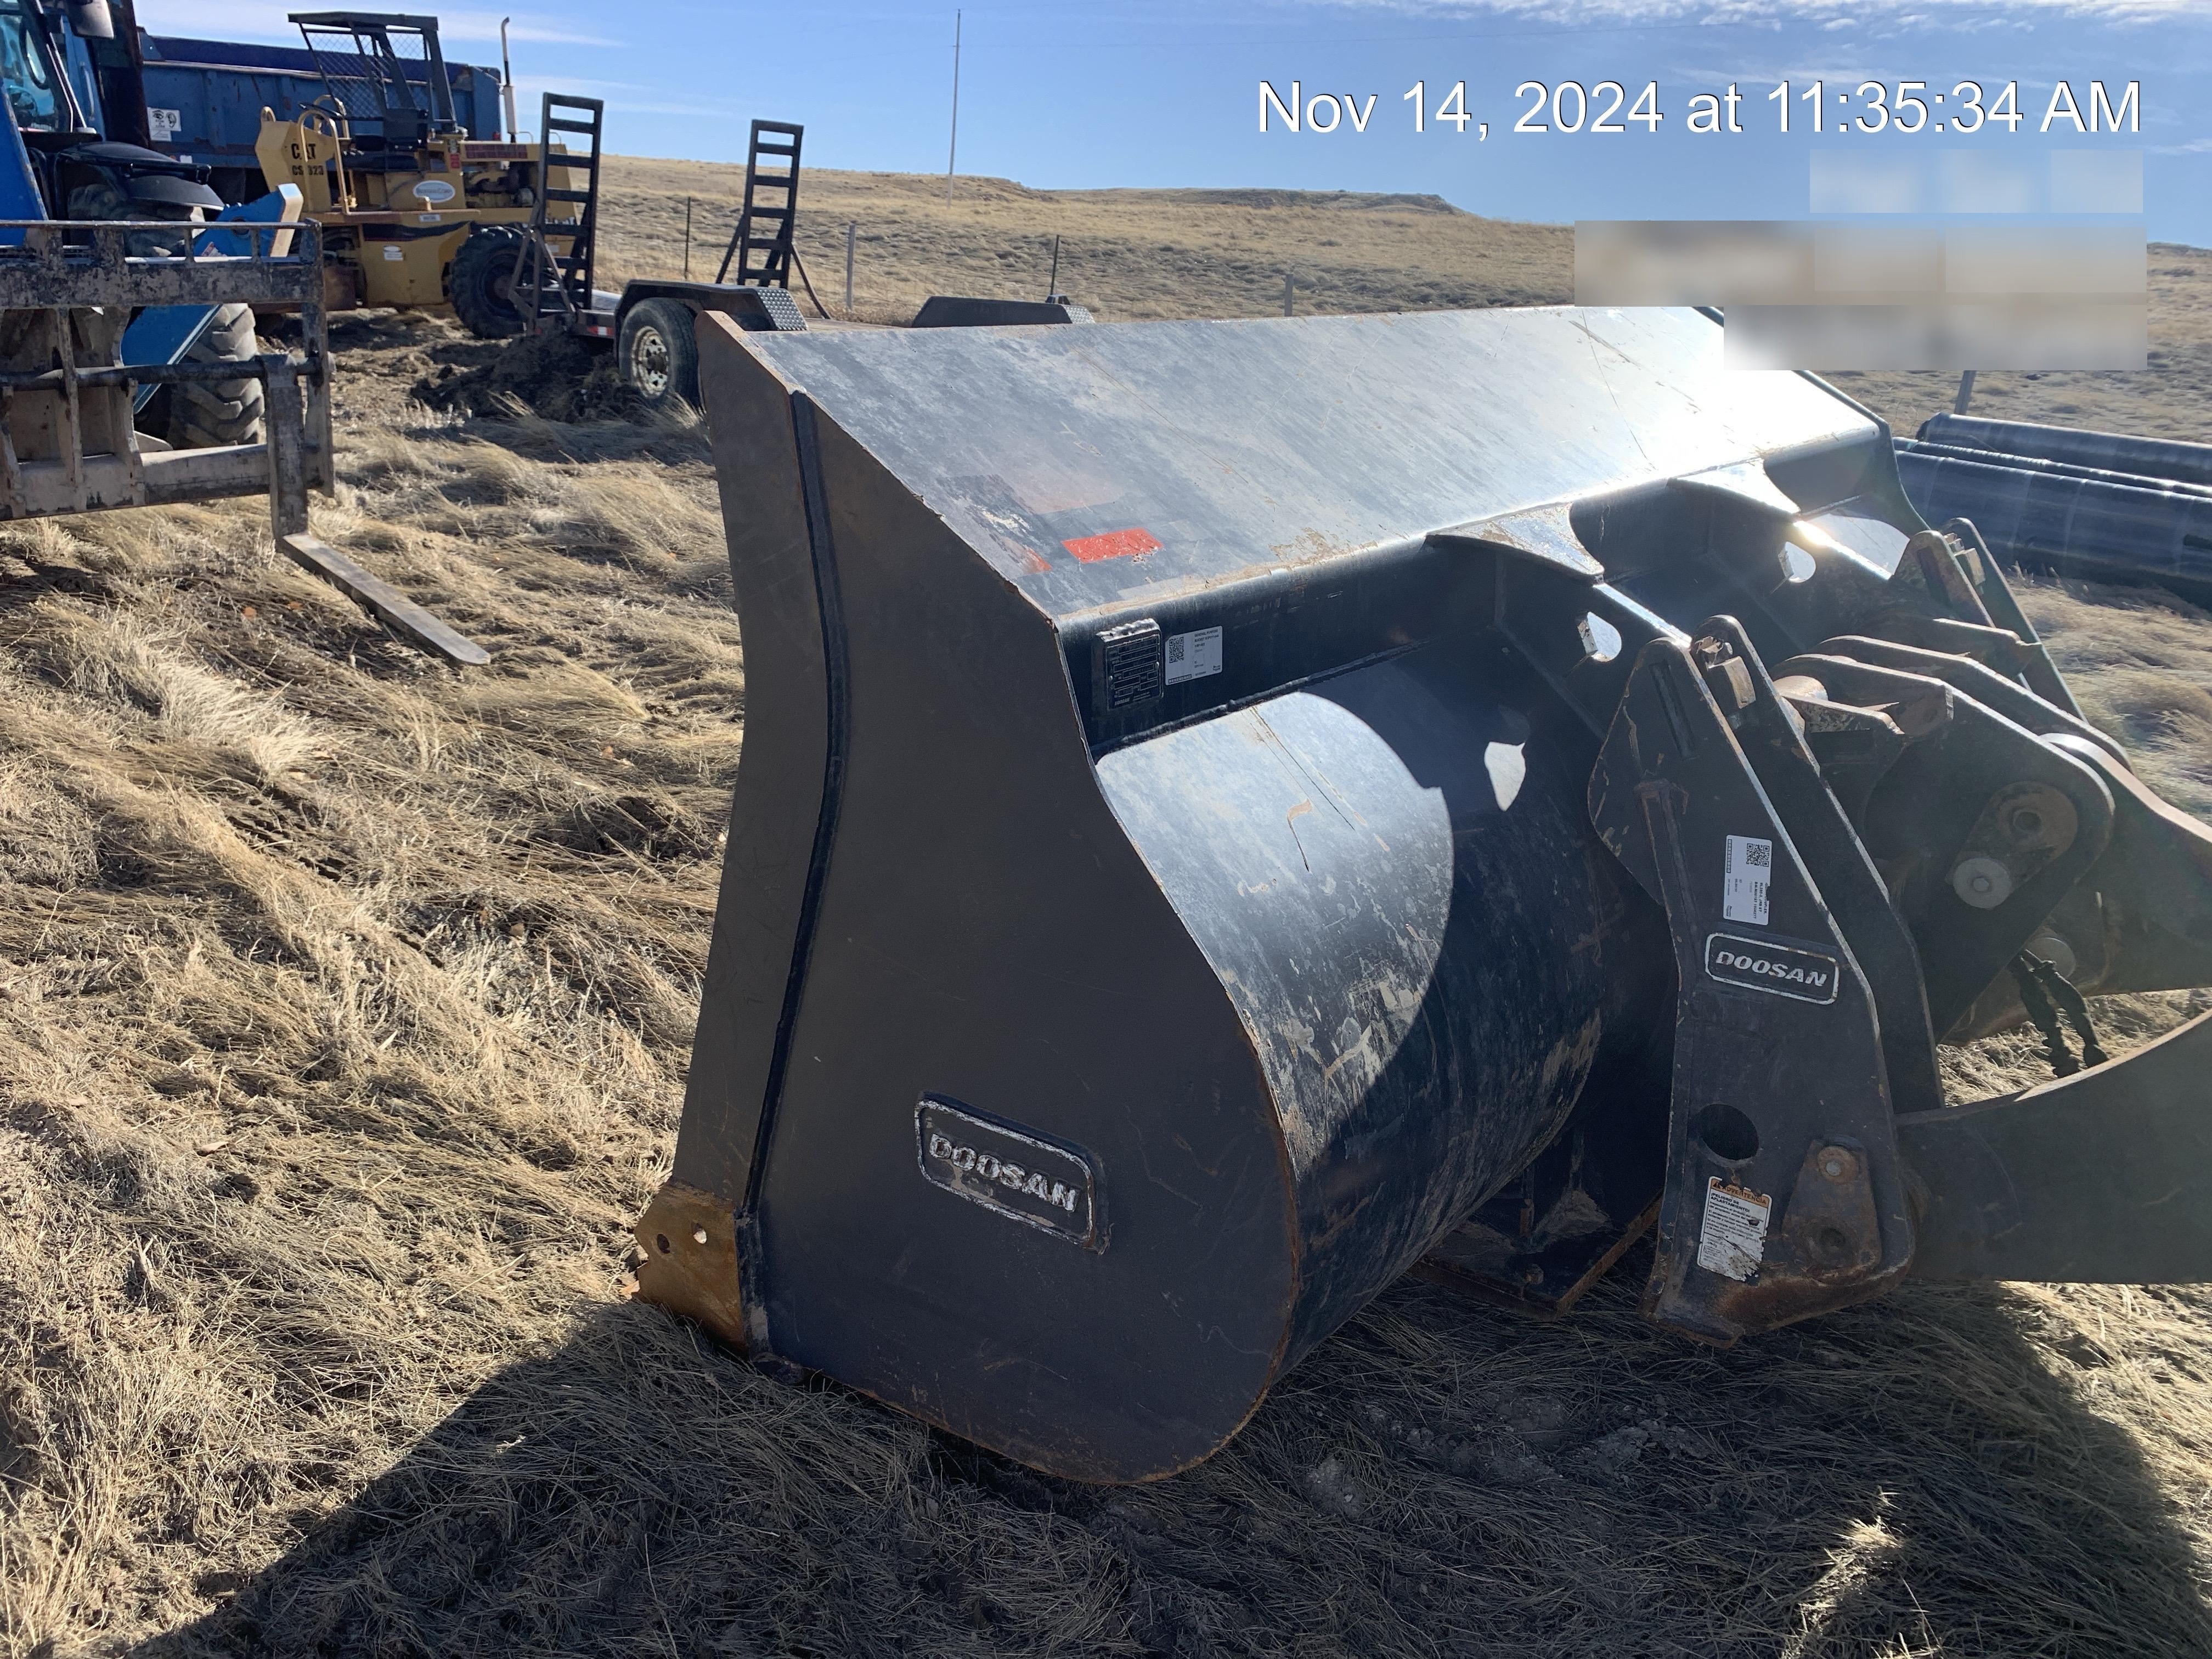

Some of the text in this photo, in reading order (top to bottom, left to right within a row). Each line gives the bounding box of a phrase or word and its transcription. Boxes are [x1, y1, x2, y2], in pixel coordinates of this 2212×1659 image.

[1716, 951, 1827, 987] DOOSAN
[929, 1133, 1080, 1214] DOOSAN
[1723, 1186, 1767, 1205] ADVERTENCIA
